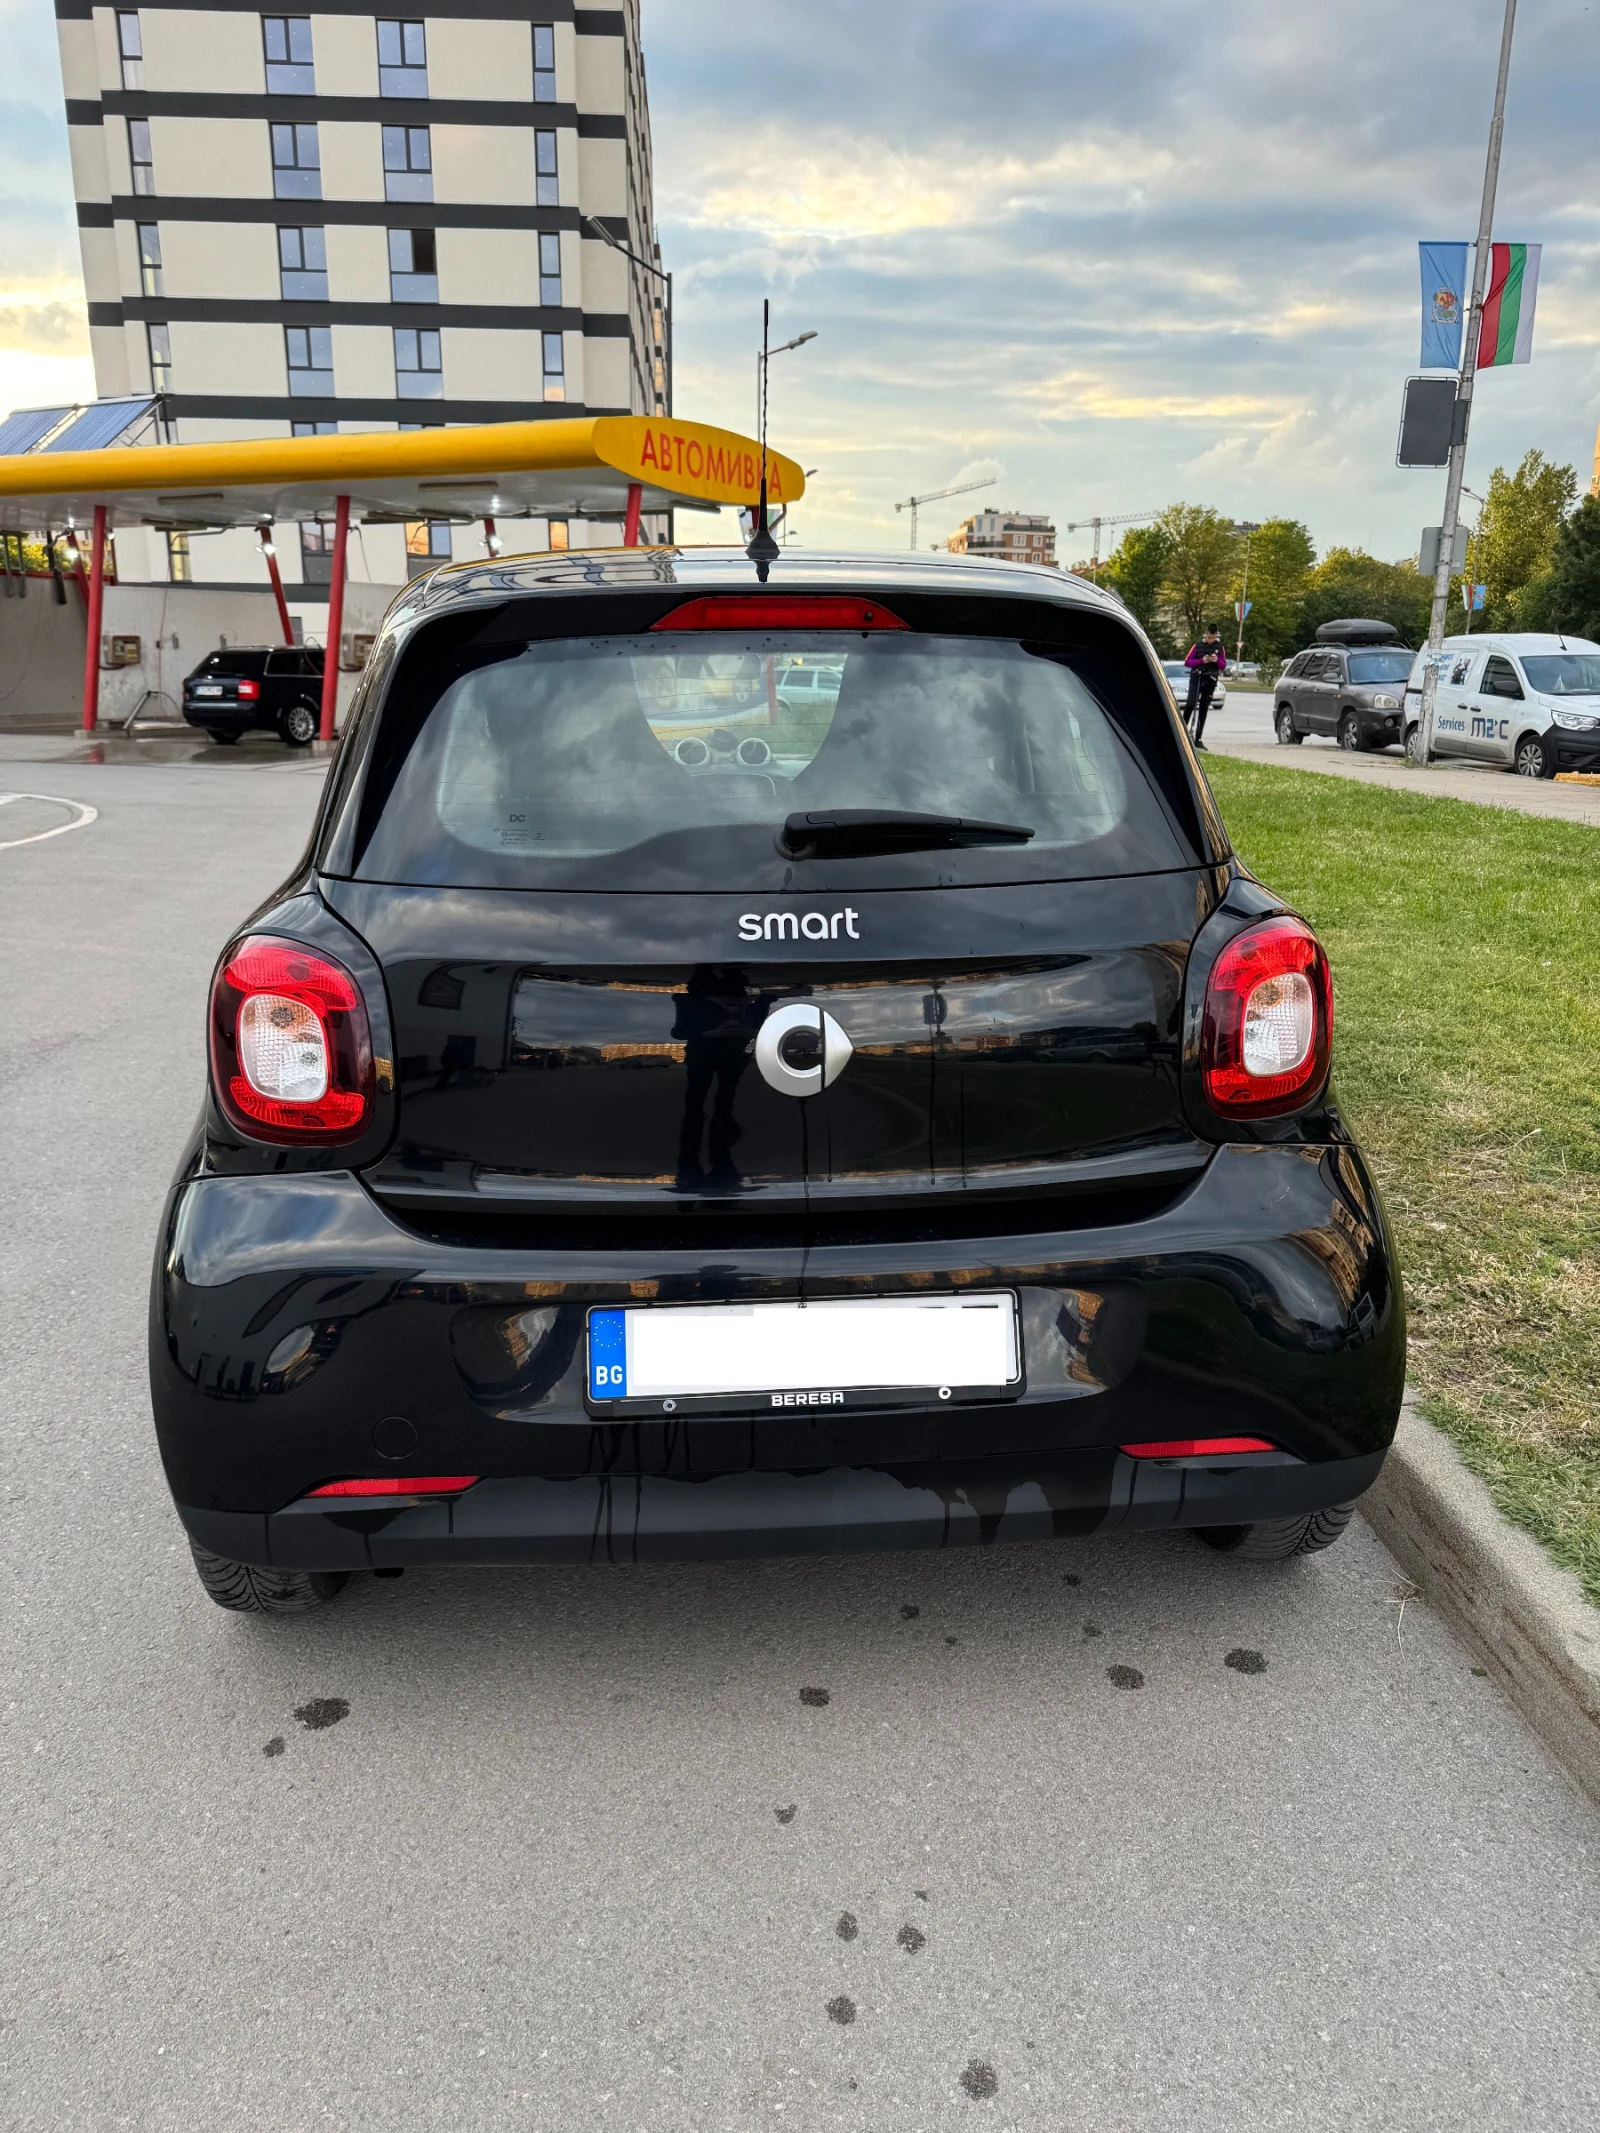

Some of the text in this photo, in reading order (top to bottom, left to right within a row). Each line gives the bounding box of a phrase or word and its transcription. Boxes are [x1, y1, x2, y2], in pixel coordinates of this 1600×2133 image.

[641, 428, 782, 497] АВТОМИВКА
[1437, 715, 1465, 731] Services
[738, 908, 860, 941] smart
[596, 1365, 623, 1385] BG
[771, 1392, 844, 1407] BERESA
